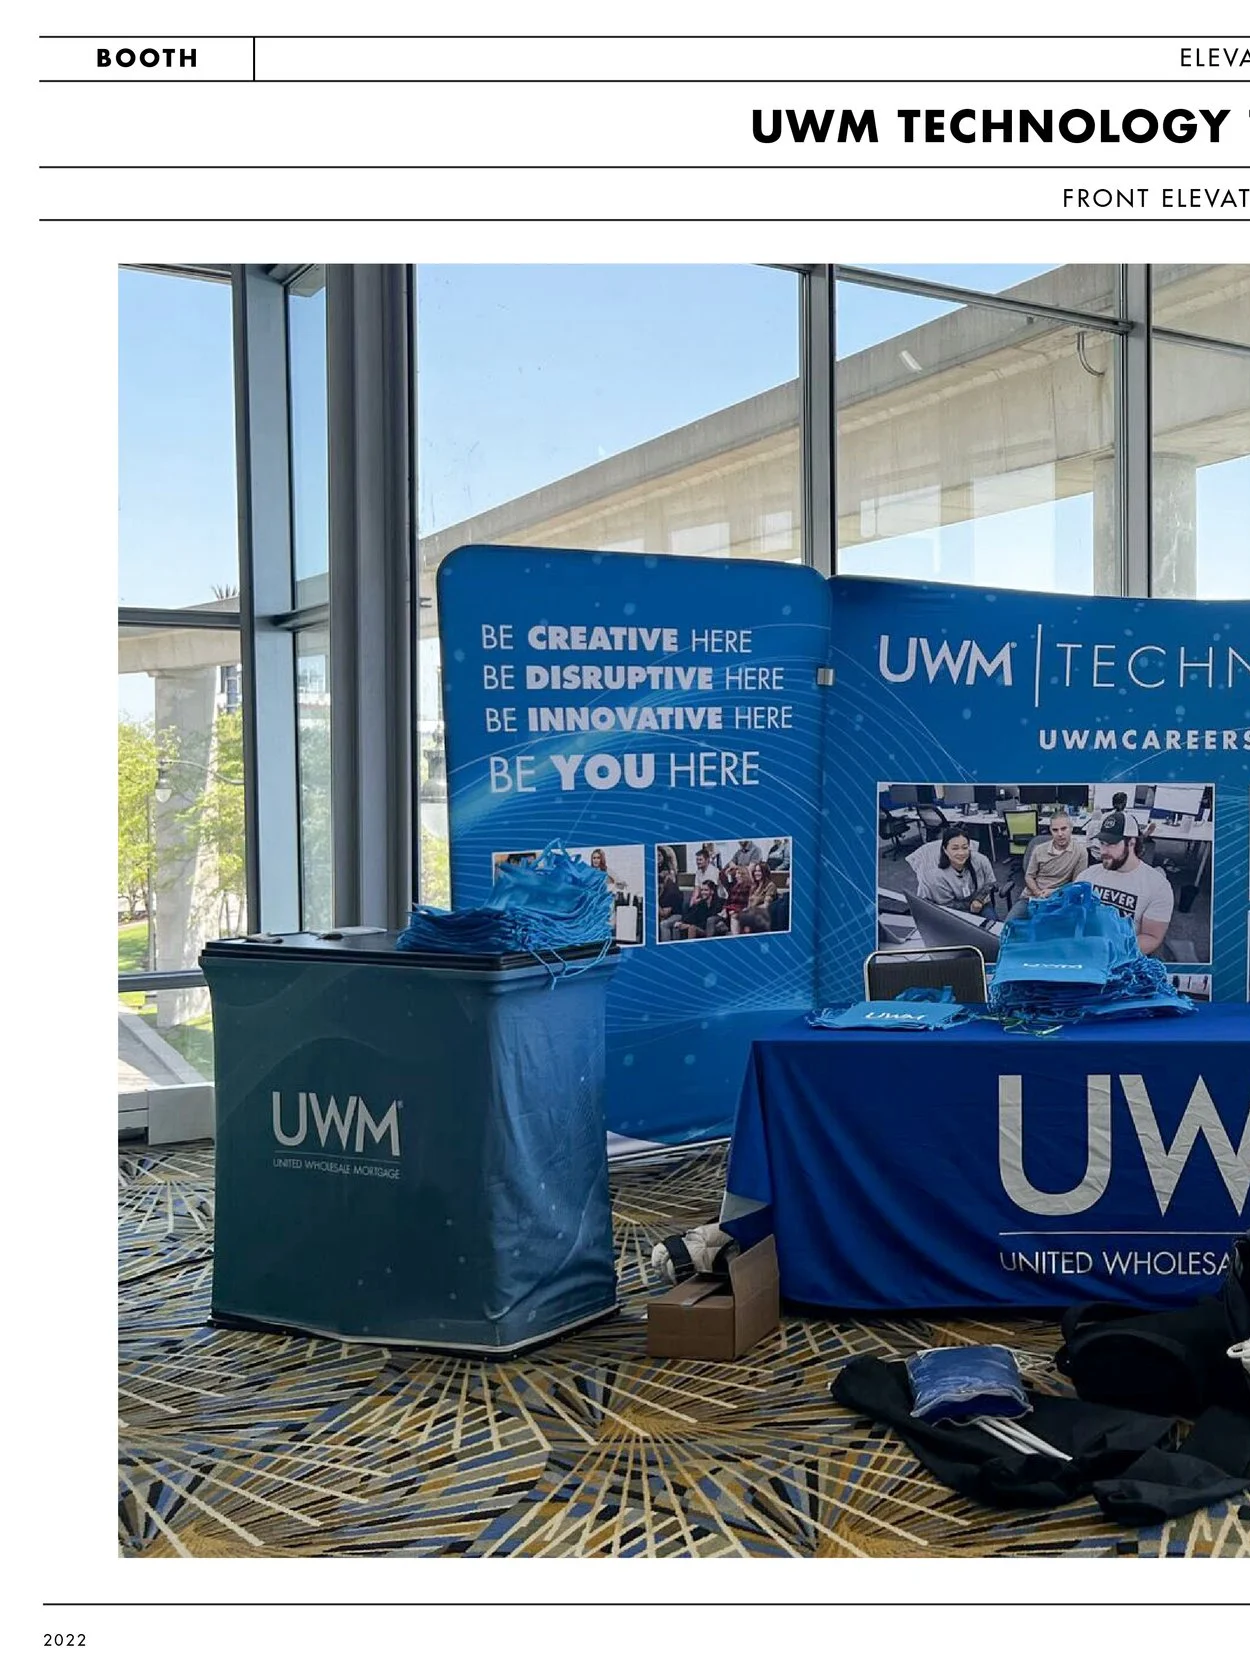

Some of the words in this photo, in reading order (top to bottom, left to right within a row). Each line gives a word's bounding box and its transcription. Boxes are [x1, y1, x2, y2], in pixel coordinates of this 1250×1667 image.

[481, 624, 514, 650] BE
[528, 625, 679, 651] CREATIVE
[692, 629, 753, 653] HERE
[483, 665, 515, 690] BE
[525, 665, 713, 691] DISRUPTIVE
[725, 667, 785, 691] HERE
[485, 707, 518, 732] BE
[527, 706, 724, 731] INNOVATIVE
[735, 706, 793, 730] HERE
[489, 755, 537, 794] BE
[550, 753, 657, 791] YOU
[669, 750, 760, 788] HERE
[1094, 886, 1135, 908] NEVER
[273, 1158, 302, 1169] UNITED
[304, 1159, 351, 1175] WHOLESALE
[353, 1166, 401, 1180] MORTGAGE
[1000, 1251, 1094, 1275] UNITED
[1103, 1251, 1231, 1276] WHOLESA
